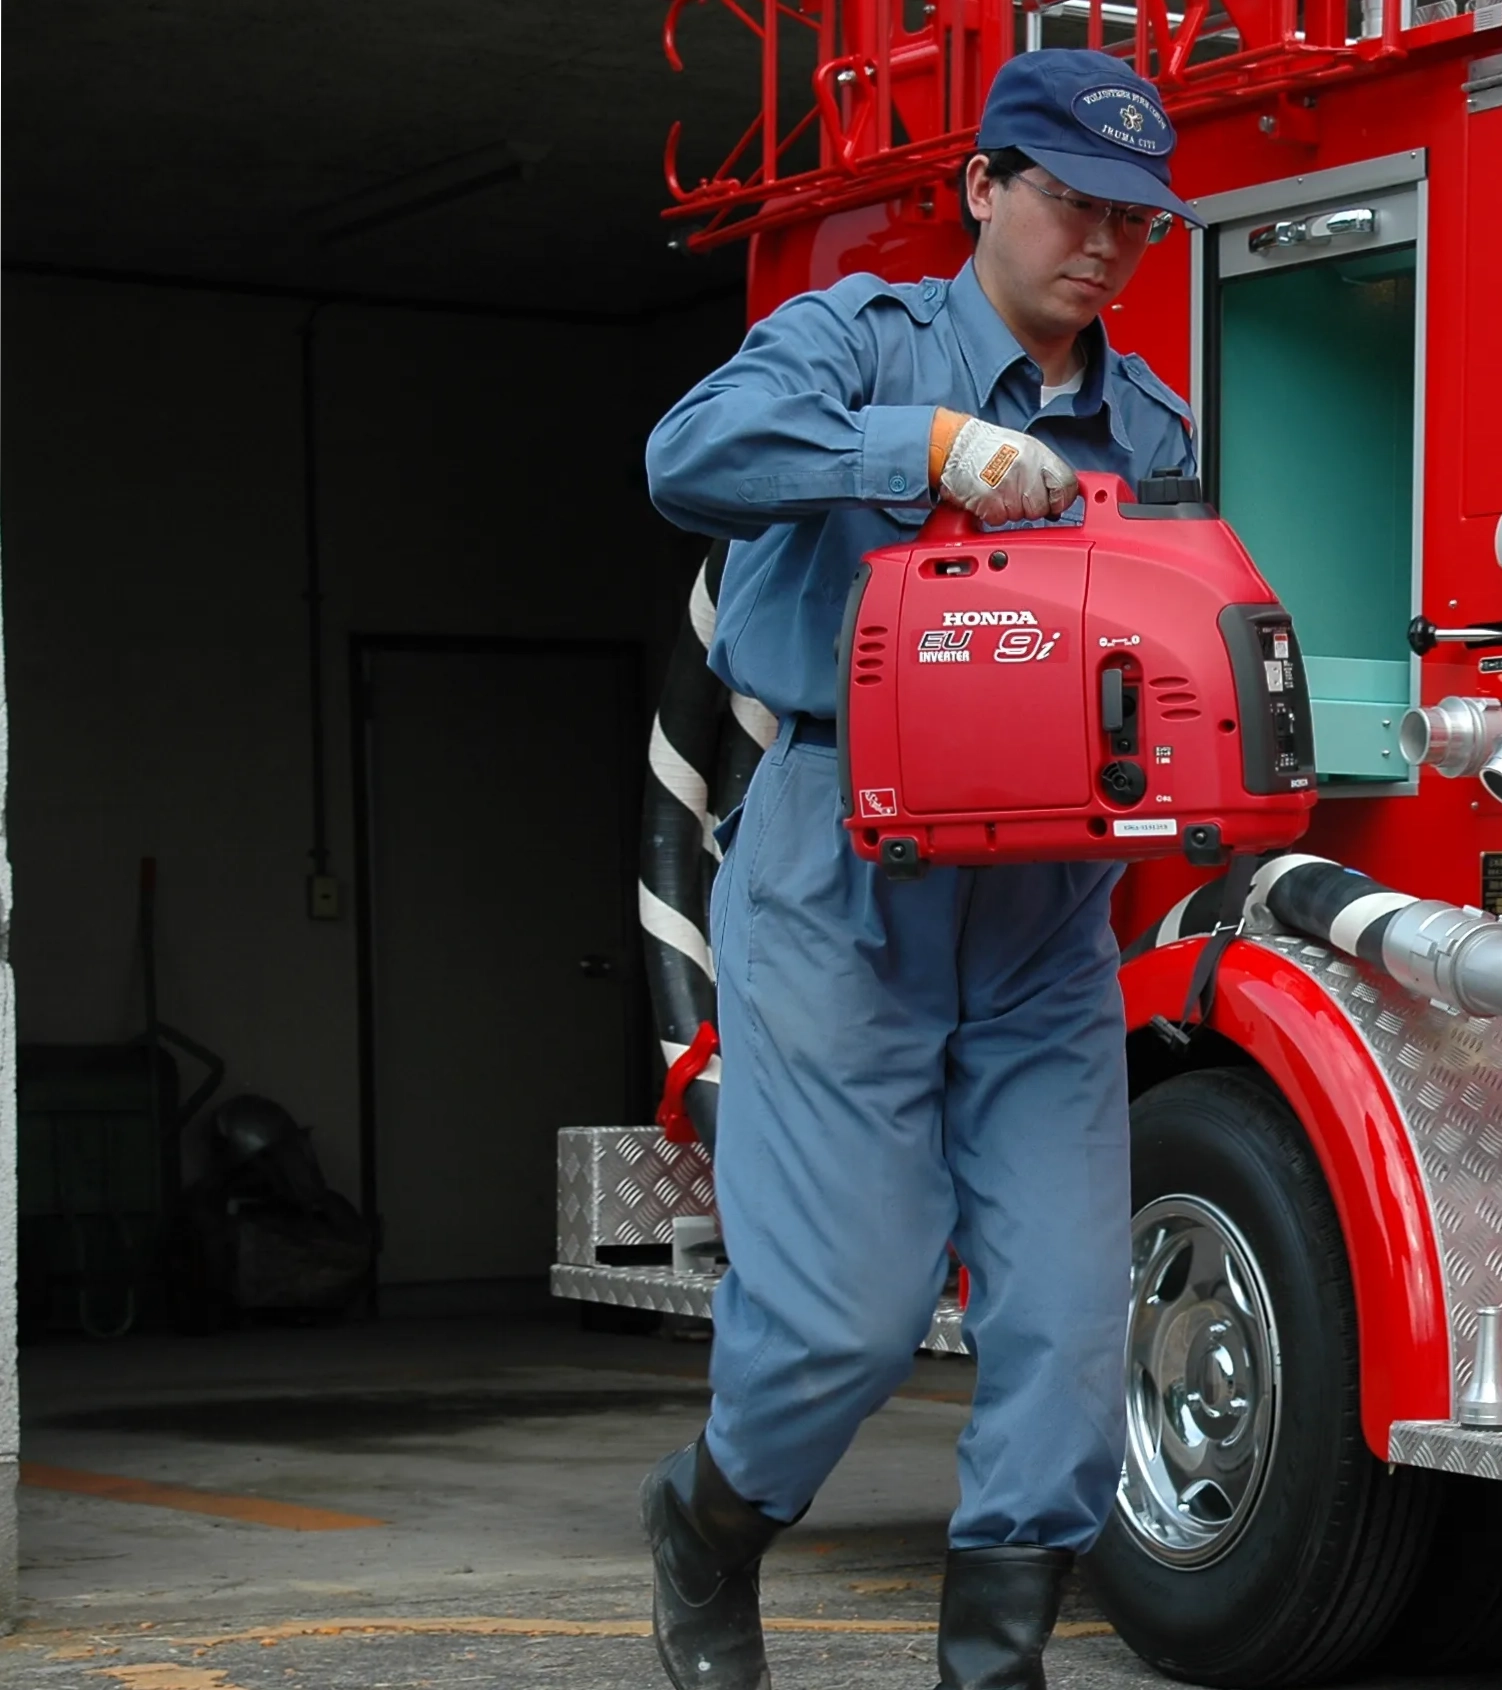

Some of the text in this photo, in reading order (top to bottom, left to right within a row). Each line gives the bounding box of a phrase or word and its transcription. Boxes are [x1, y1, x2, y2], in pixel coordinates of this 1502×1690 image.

[943, 611, 1038, 626] HONDA
[918, 630, 973, 651] EU
[919, 650, 970, 662] INVERTER
